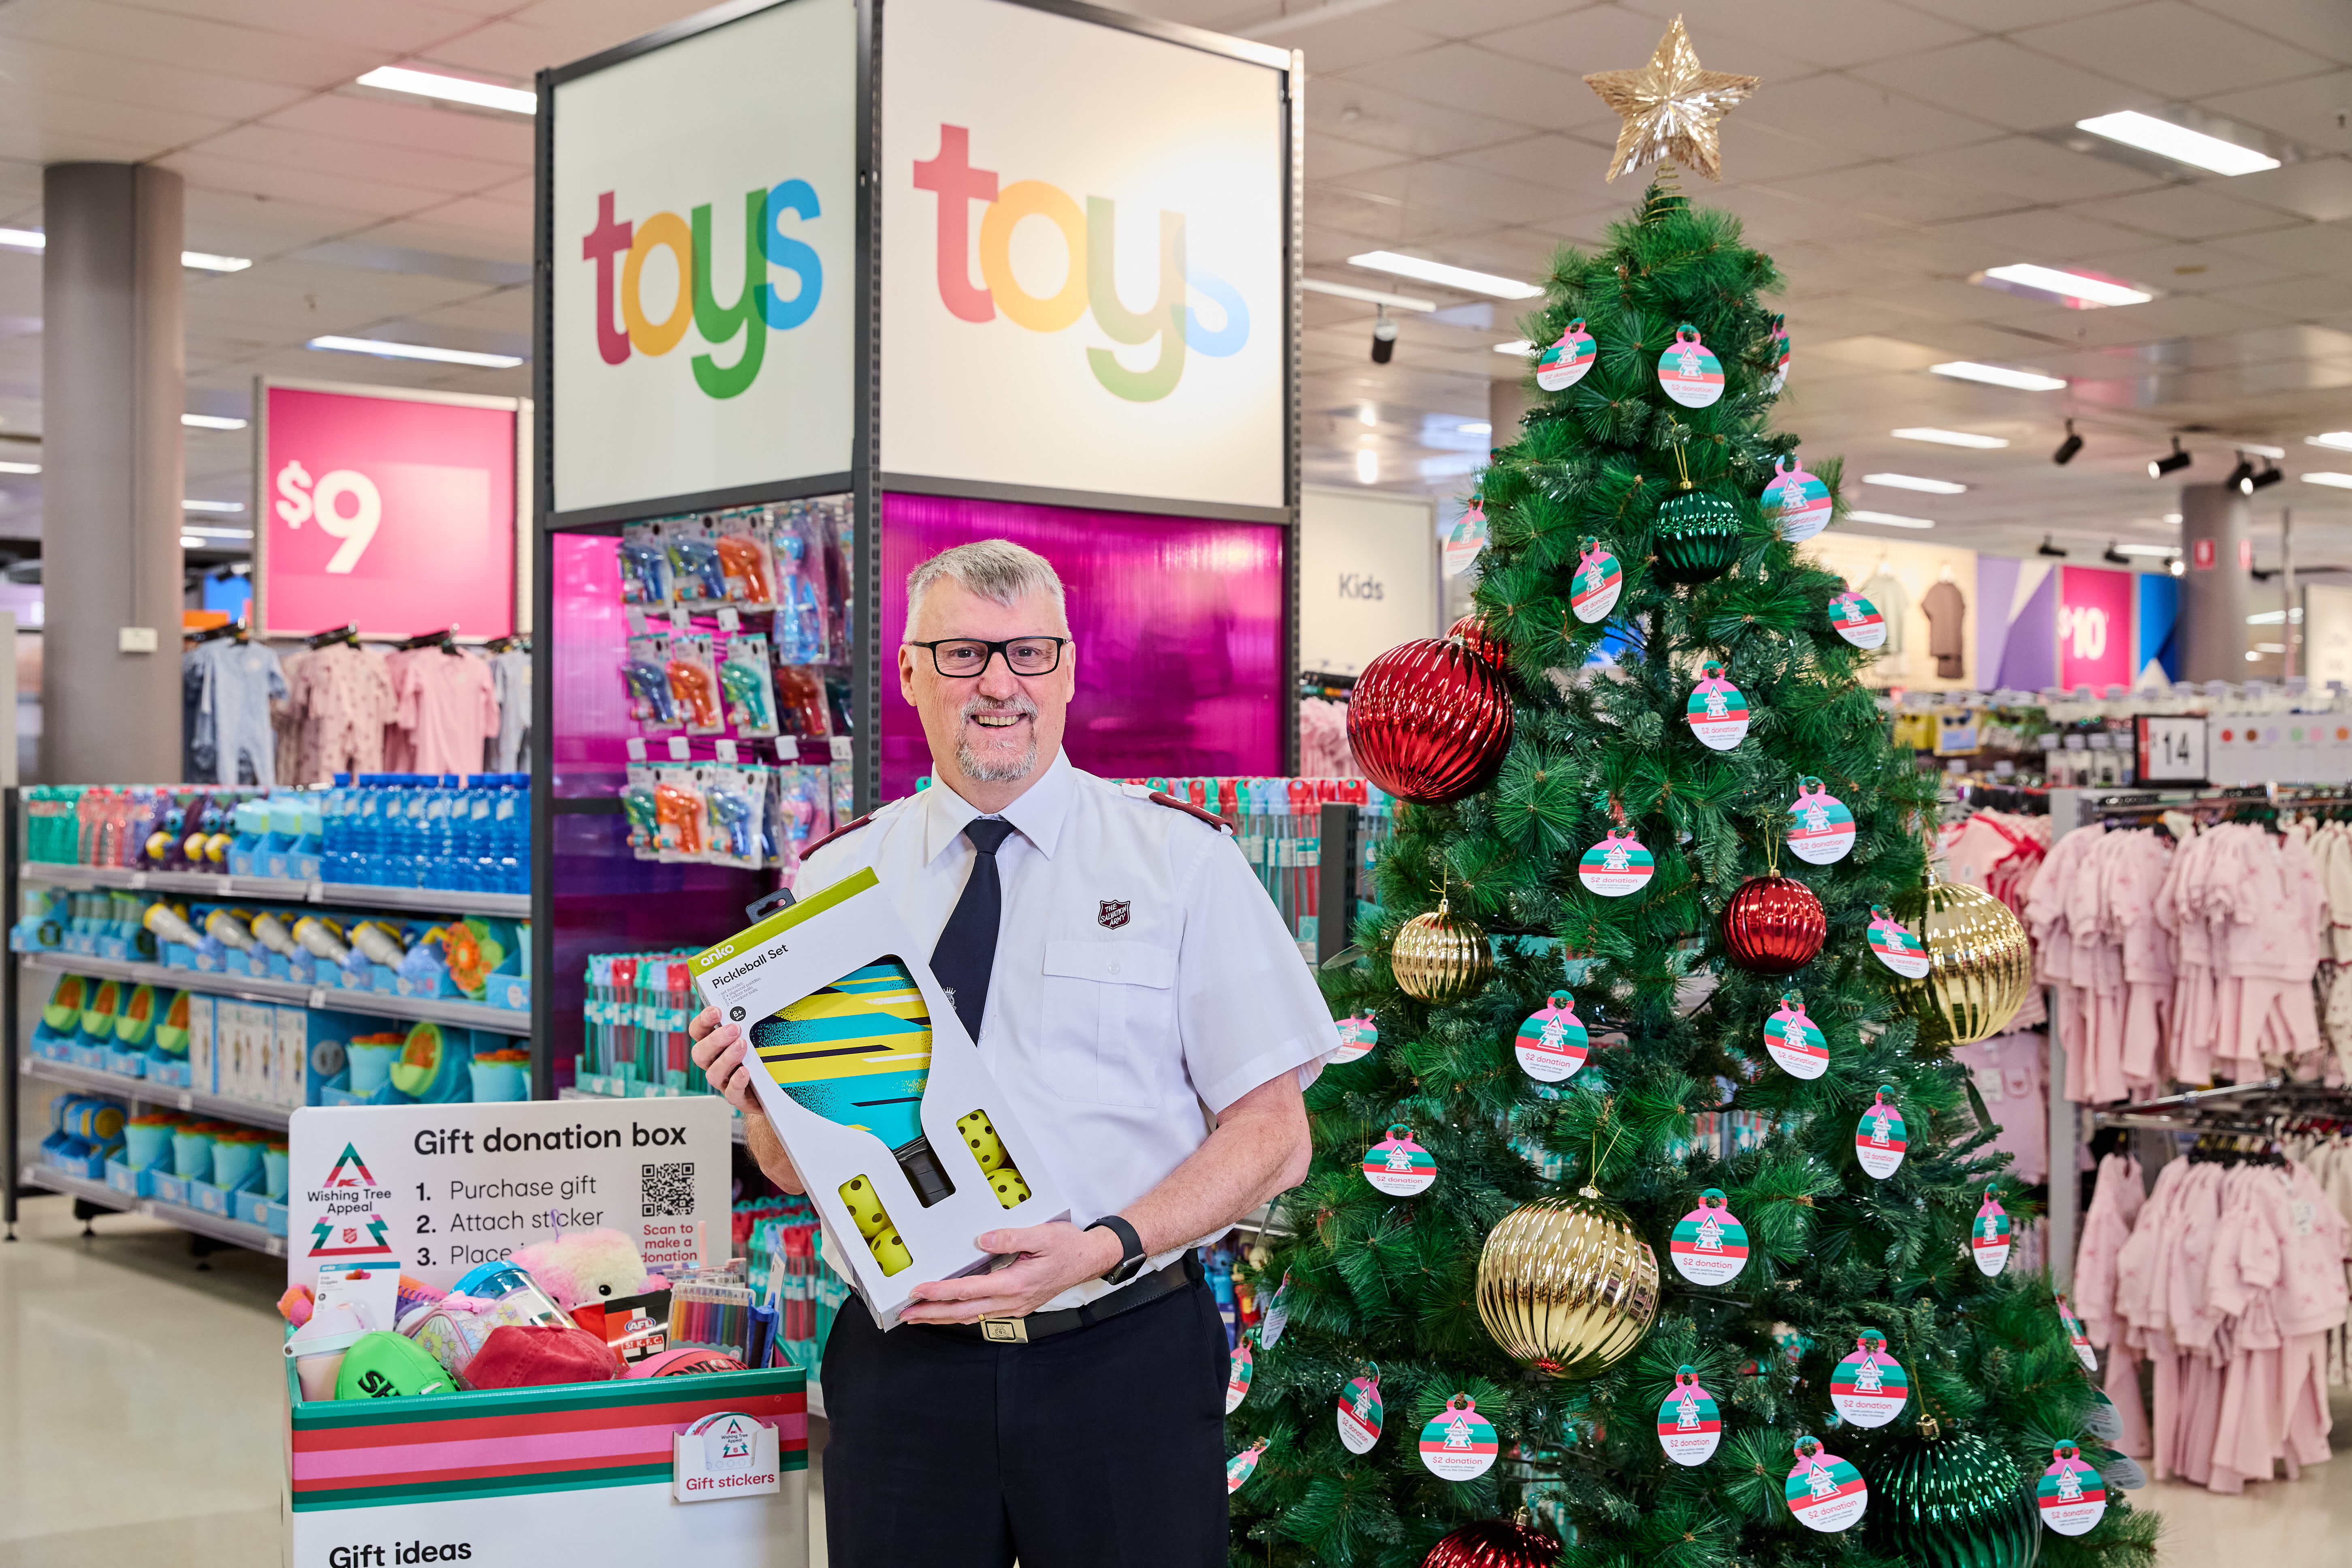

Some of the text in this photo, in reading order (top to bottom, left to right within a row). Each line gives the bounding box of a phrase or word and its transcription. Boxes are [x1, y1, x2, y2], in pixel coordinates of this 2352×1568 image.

[913, 122, 1251, 403] toys
[583, 179, 823, 400] toys
[275, 461, 382, 574] $9
[1339, 574, 1385, 600] Kids
[1590, 591, 1614, 608] donation
[1812, 839, 1844, 849] donation
[1101, 905, 1126, 923] SALVATION
[1105, 903, 1117, 912] THE
[1109, 913, 1125, 926] ARMY
[701, 945, 734, 966] anko
[712, 944, 788, 988] Pickleball Set
[729, 985, 745, 996] plywood
[746, 977, 761, 987] paddles
[733, 993, 748, 1003] outdoor
[1525, 1053, 1570, 1067] $2 donation
[1788, 1054, 1818, 1067] donation
[414, 1122, 687, 1155] Gift donation box
[308, 1189, 391, 1202] Wishing Tree
[416, 1175, 596, 1201] 1. Purchase gift
[327, 1201, 372, 1216] Appeal
[416, 1215, 436, 1234] 2.
[450, 1210, 524, 1232] Attach
[643, 1223, 693, 1235] Scan to
[645, 1237, 692, 1249] make a
[416, 1244, 512, 1266] 3. Place
[1695, 1259, 1732, 1269] donation
[628, 1319, 653, 1331] AFL
[1855, 1401, 1892, 1409] donation
[1342, 1417, 1349, 1426] $2
[1349, 1423, 1368, 1444] donation
[1670, 1438, 1710, 1447] $2 donation
[686, 1473, 775, 1490] Gift stickers
[1808, 1510, 1818, 1519] $2
[1821, 1500, 1857, 1515] donation
[2063, 1508, 2095, 1517] donation
[329, 1540, 472, 1568] Gift ideas
